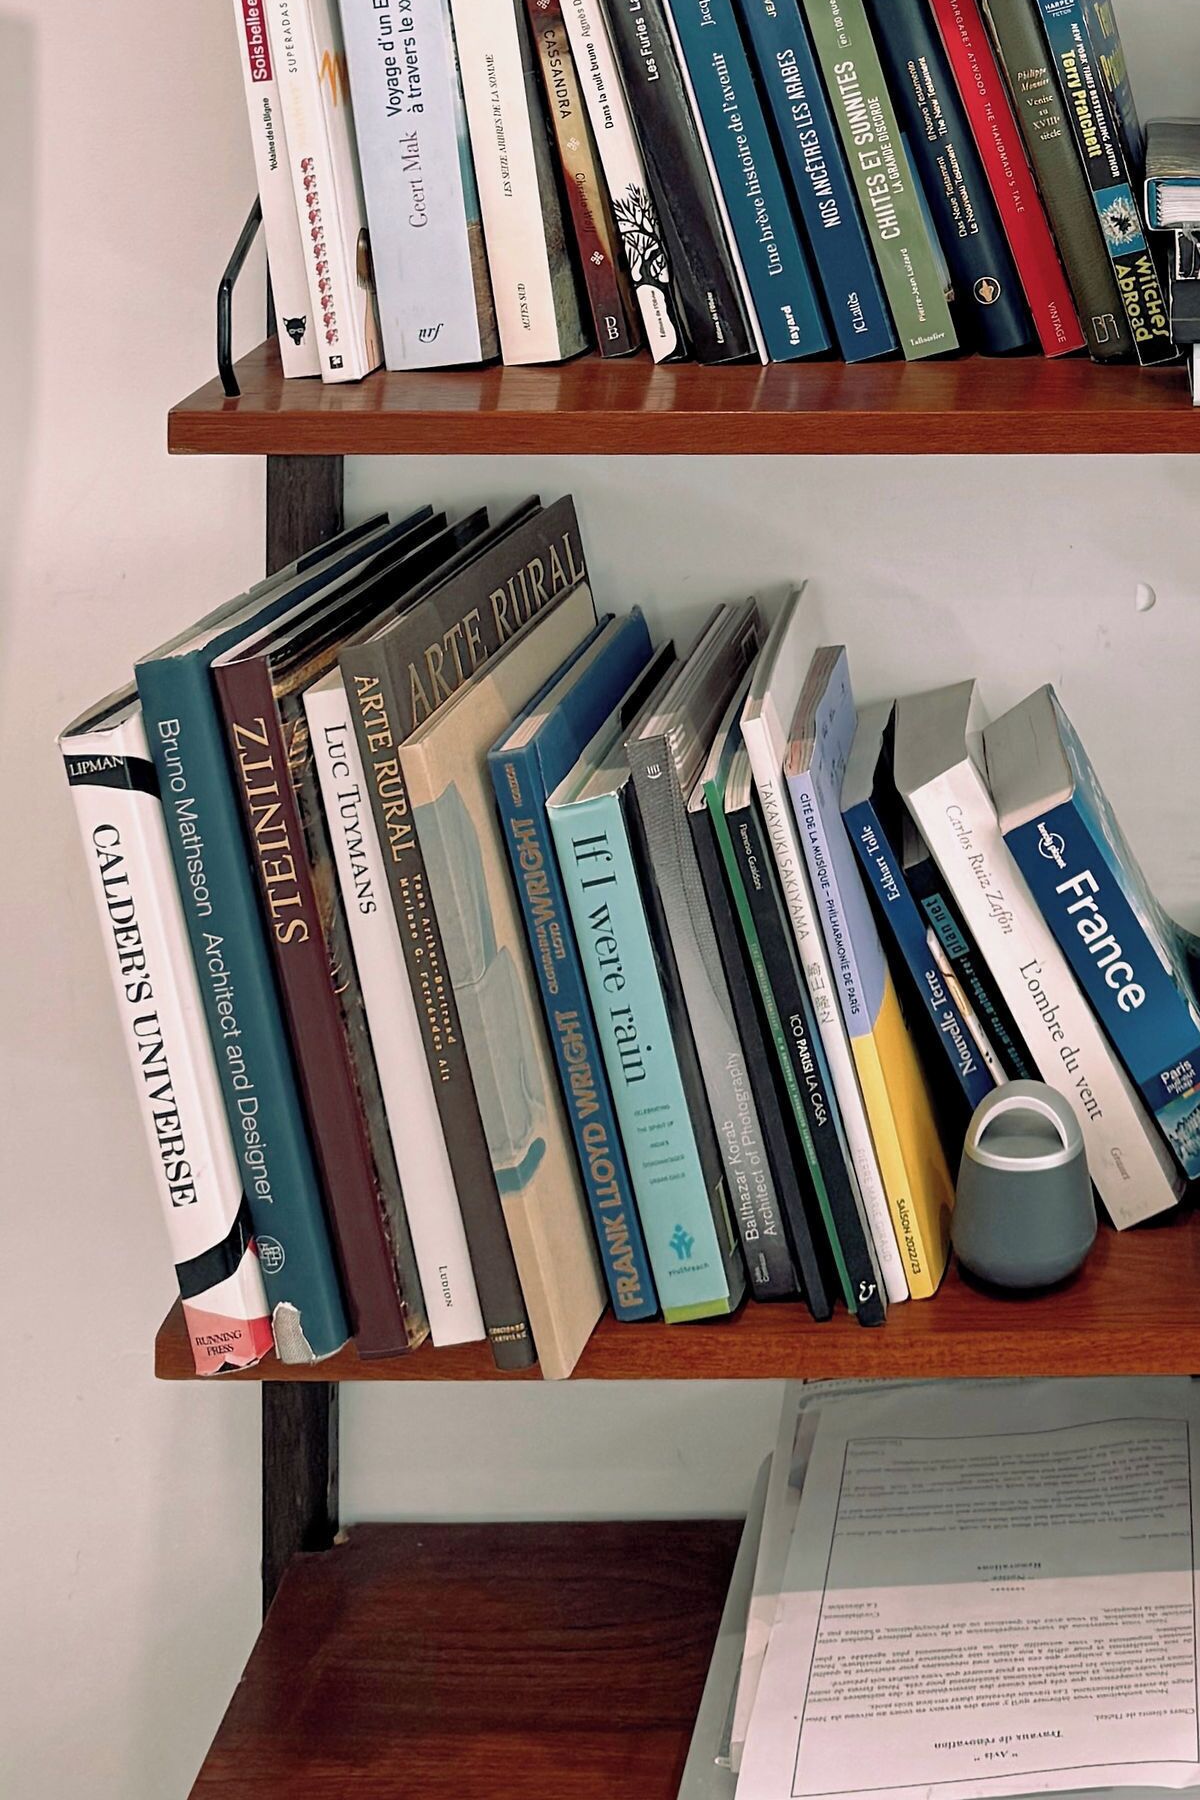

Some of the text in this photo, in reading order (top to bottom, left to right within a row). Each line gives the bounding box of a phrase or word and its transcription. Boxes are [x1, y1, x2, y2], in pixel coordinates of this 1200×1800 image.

[244, 6, 263, 45] belle
[250, 44, 269, 81] Sois
[377, 14, 394, 51] d'un
[397, 17, 414, 32] le
[635, 17, 652, 57] Furies
[384, 56, 404, 117] Voyage
[403, 37, 422, 98] travers
[406, 103, 424, 113] à
[543, 29, 571, 119] CASSANDRA
[645, 57, 660, 82] Les
[967, 52, 986, 96] ATWOOD
[727, 112, 743, 132] de
[776, 49, 841, 228] NOS ANCÊTRES LES ARABES
[831, 59, 900, 240] CHIITES ET SUNNITES
[867, 96, 904, 193] LA GRANDE DISCORDE
[984, 102, 995, 121] THE
[1012, 190, 1024, 212] TALE
[398, 130, 427, 227] Geert Mak
[736, 134, 761, 196] histoire
[753, 197, 774, 242] brève
[766, 243, 783, 275] Une
[1047, 301, 1066, 342] VINTAGE
[408, 532, 587, 708] ARTE RURAL
[69, 755, 125, 777] LIPMAN
[353, 675, 417, 863] ARTE RURAL
[232, 717, 309, 943] STEINITZ
[860, 825, 900, 901] Eckhart Tolle
[157, 718, 273, 1203] Bruno Mathsson Architect and Designer
[571, 831, 652, 1084] If I were rain
[1055, 869, 1145, 1012] France
[925, 970, 978, 1076] Nouvelle Terre
[132, 1010, 197, 1207] UNIVERSE
[789, 1013, 827, 1126] ICO PARISI LA CASA
[1059, 1046, 1080, 1074] du
[1075, 1075, 1102, 1121] vent
[554, 1007, 645, 1308] FRANK LLOYD WRIGHT
[721, 1120, 760, 1241] Balthazar Korab
[723, 1048, 778, 1237] Architect of Photography
